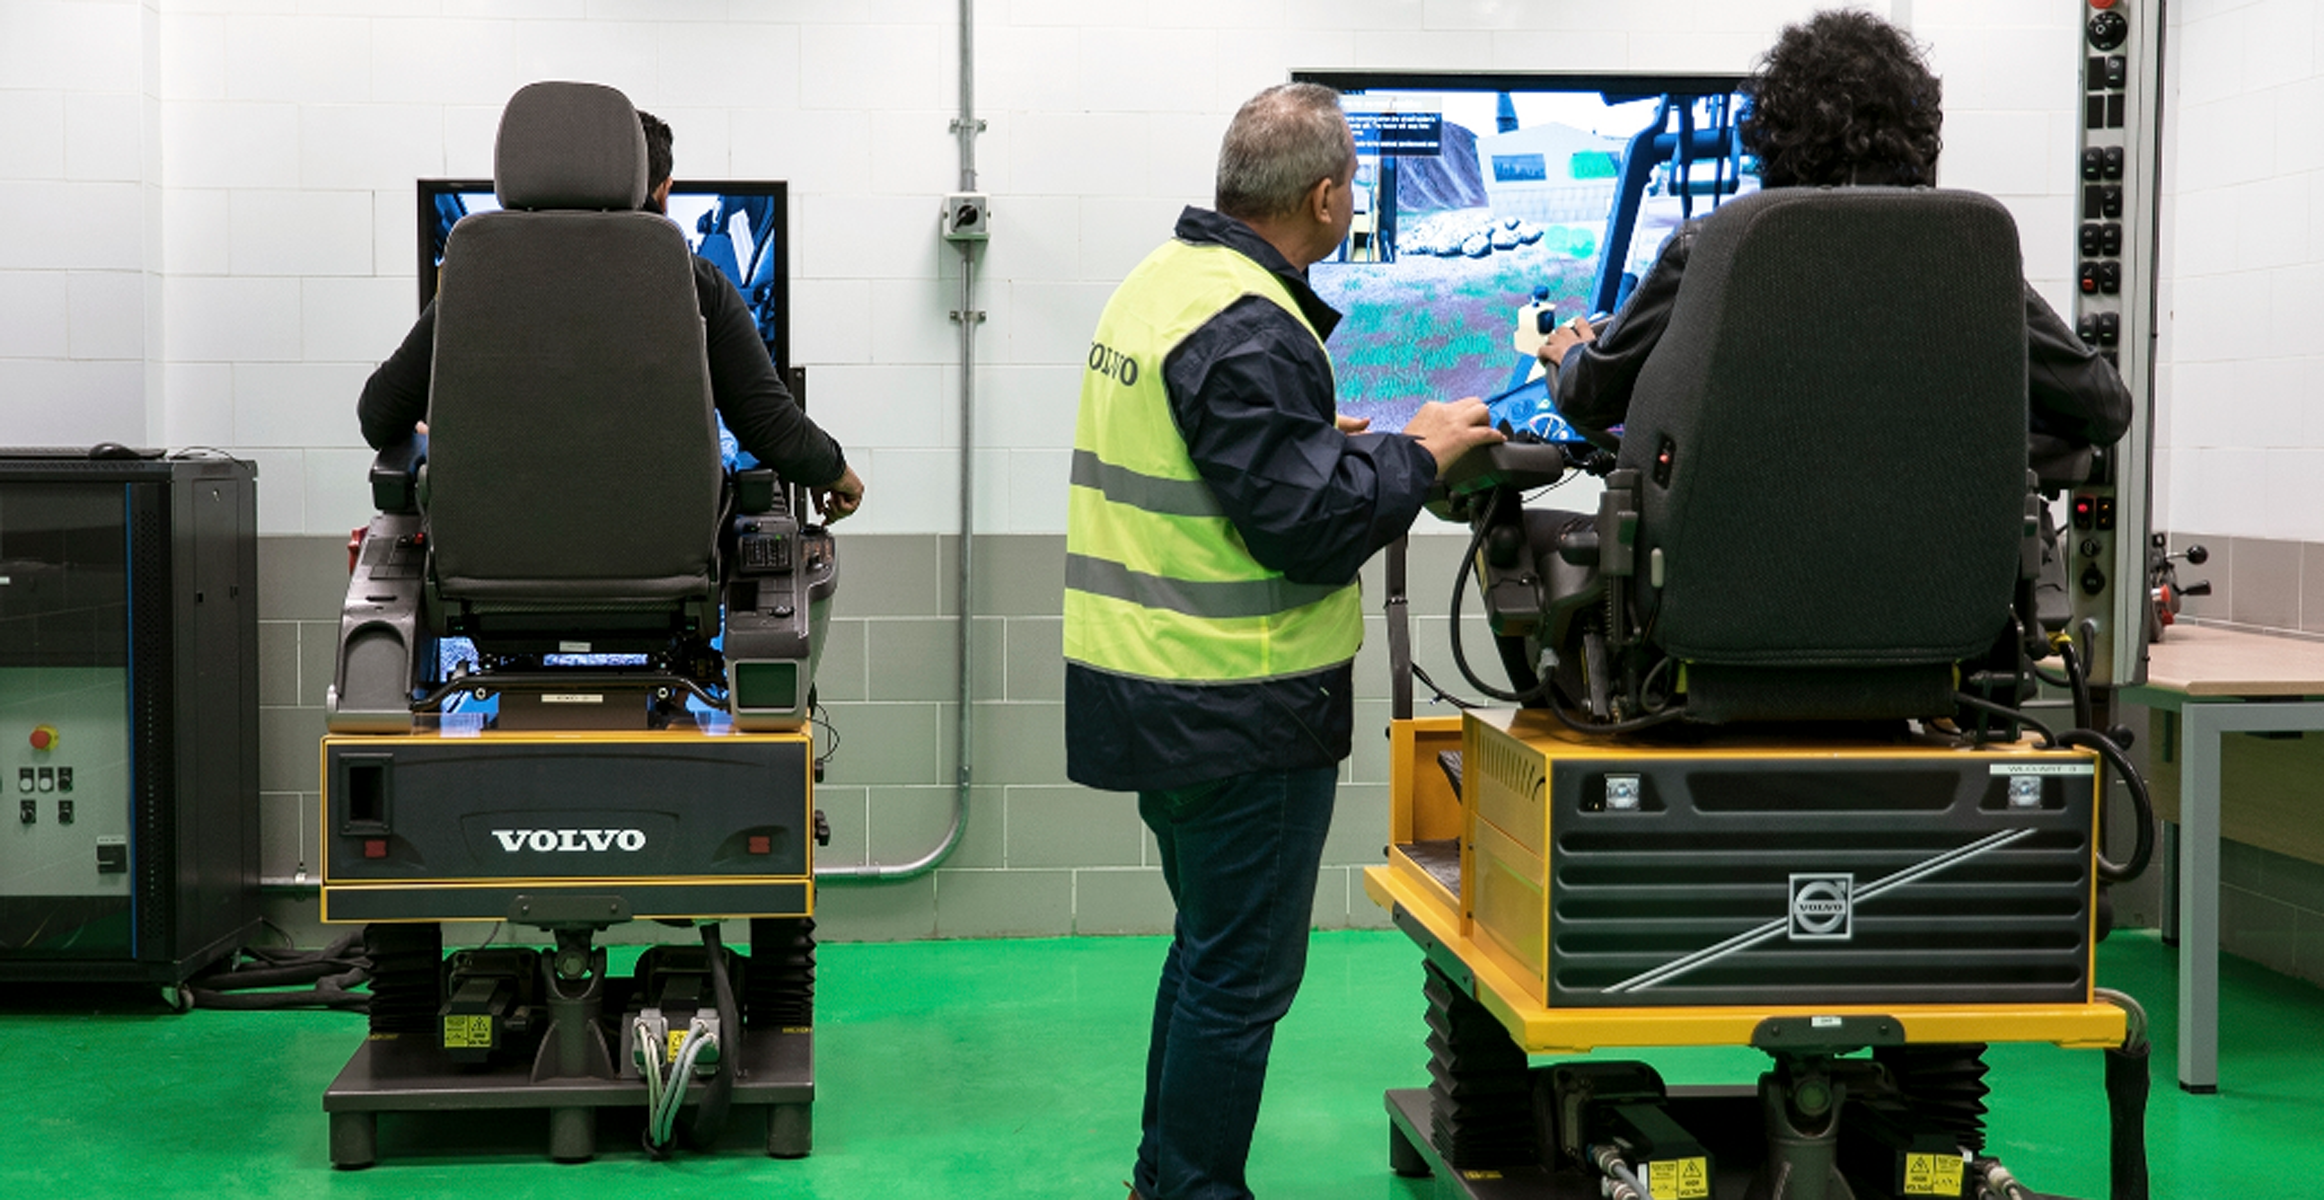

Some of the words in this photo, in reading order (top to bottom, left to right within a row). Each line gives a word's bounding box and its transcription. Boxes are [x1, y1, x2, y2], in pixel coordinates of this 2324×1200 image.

[1089, 341, 1138, 387] OLVO
[491, 829, 646, 852] VOLVO
[1800, 904, 1842, 912] VOLVO
